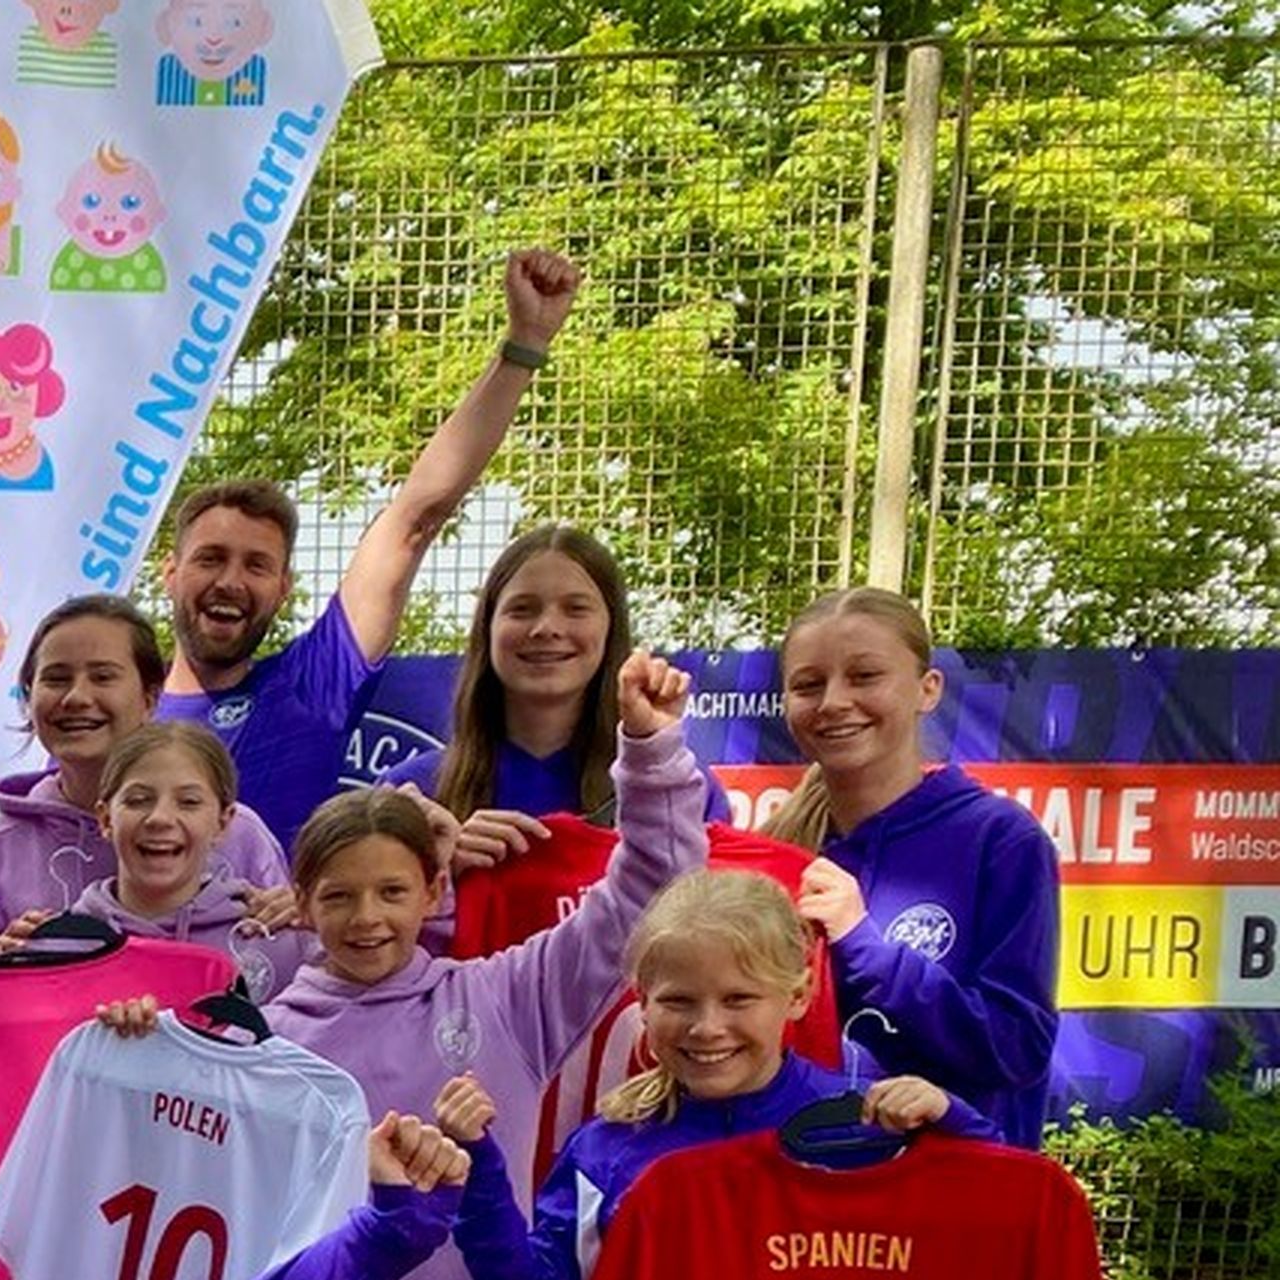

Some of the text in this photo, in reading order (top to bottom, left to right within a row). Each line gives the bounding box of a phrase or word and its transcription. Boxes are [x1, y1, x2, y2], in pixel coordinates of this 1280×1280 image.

[80, 104, 325, 590] sind Nachbarn.
[345, 727, 419, 776] AC
[1194, 790, 1280, 818] MOMM
[1081, 915, 1201, 979] UHR
[153, 1092, 231, 1146] POLEN
[766, 1231, 913, 1272] SPANIEN
